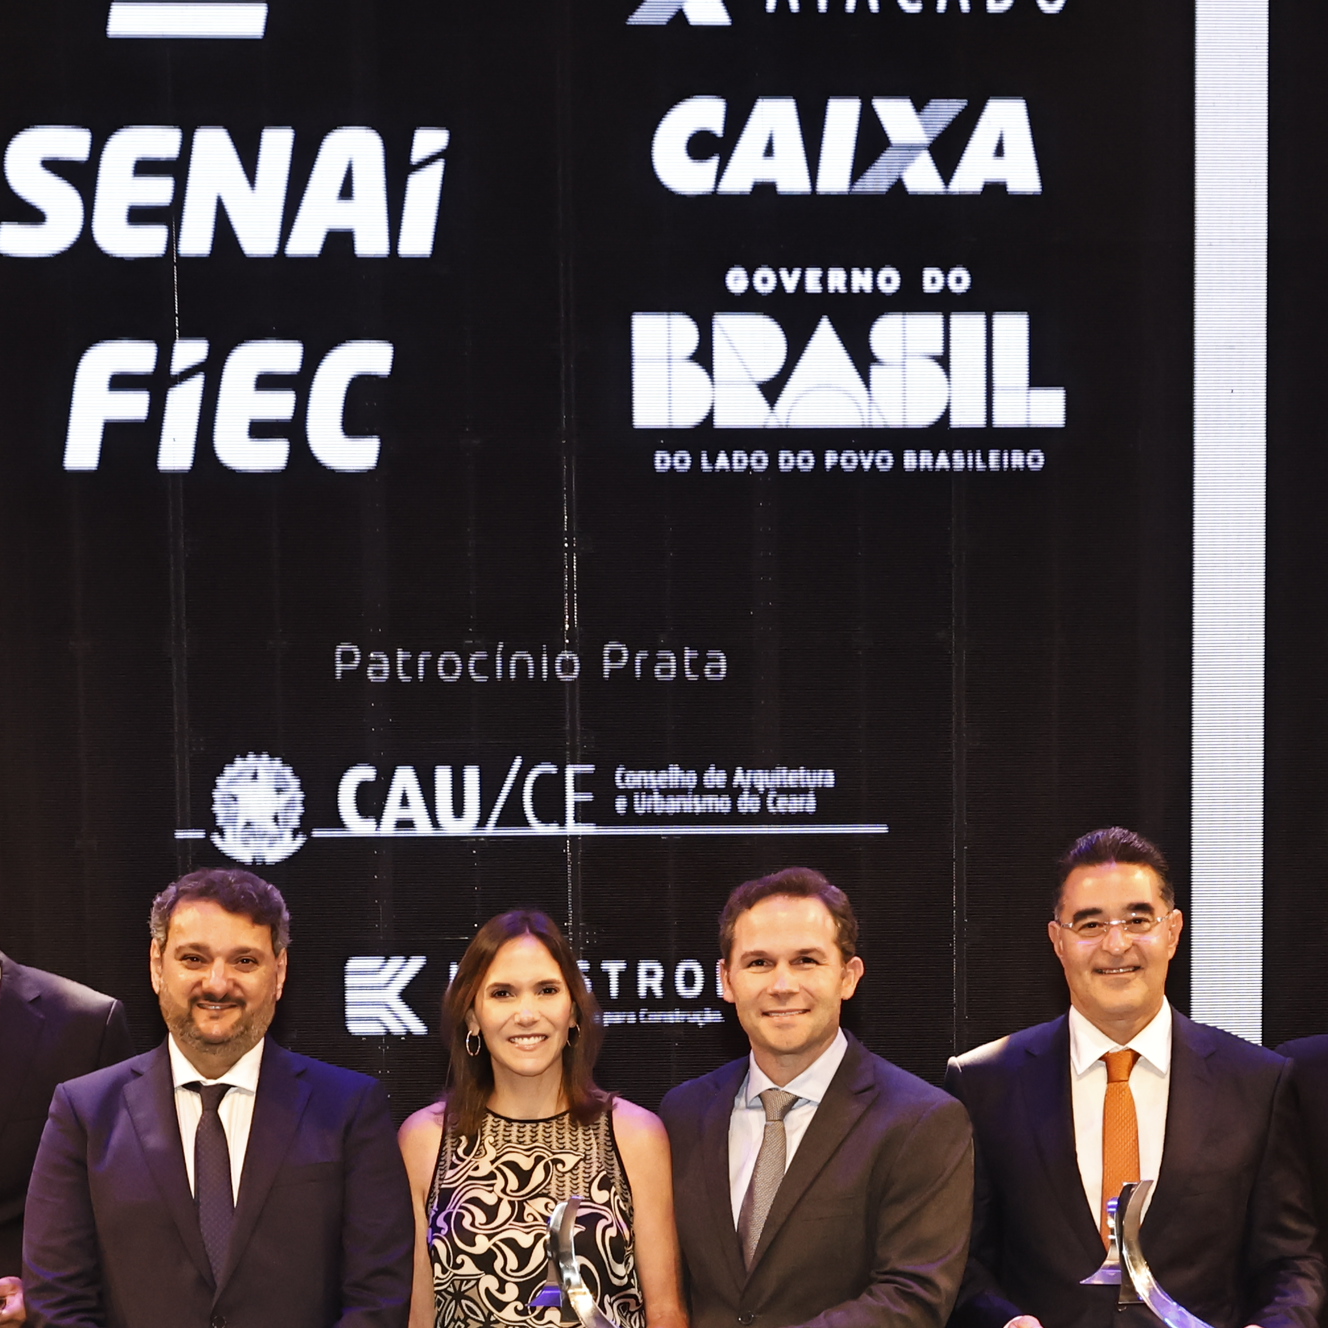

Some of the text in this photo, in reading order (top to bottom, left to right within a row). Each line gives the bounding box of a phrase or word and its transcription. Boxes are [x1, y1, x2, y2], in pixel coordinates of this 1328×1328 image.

[651, 96, 1042, 195] CAIXA
[725, 267, 971, 294] GOVERNO DO
[631, 312, 1066, 429] BRASIL
[654, 450, 1044, 472] DO LADO DO POVO BRASILEIRO
[335, 642, 727, 682] Patrocínio Prata
[338, 756, 596, 831] CAU/CE
[615, 764, 835, 793] Conselho de Arquitetura
[615, 788, 816, 814] e Urbanismo do Ceará
